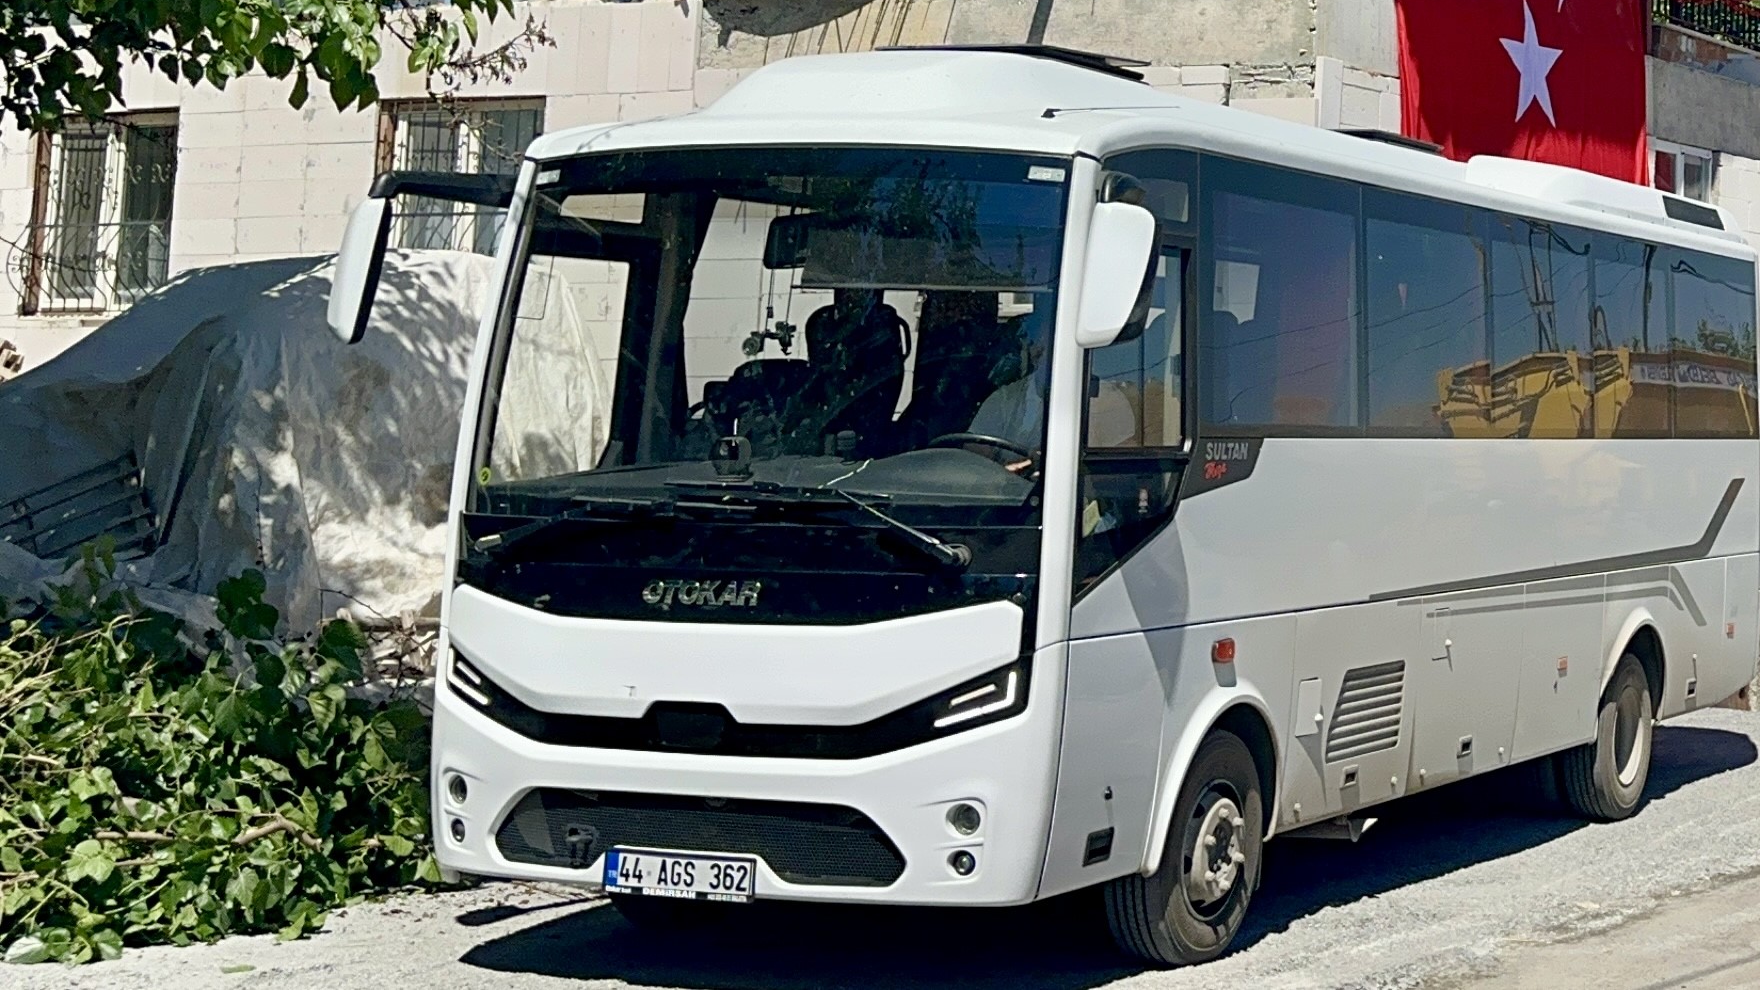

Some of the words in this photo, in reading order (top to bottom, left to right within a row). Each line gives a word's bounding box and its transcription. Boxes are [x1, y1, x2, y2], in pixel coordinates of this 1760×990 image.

[1205, 441, 1249, 460] SULTAN
[642, 579, 761, 607] OTOKAR
[619, 855, 643, 884] 44
[657, 859, 696, 888] AGS
[709, 862, 748, 893] 362
